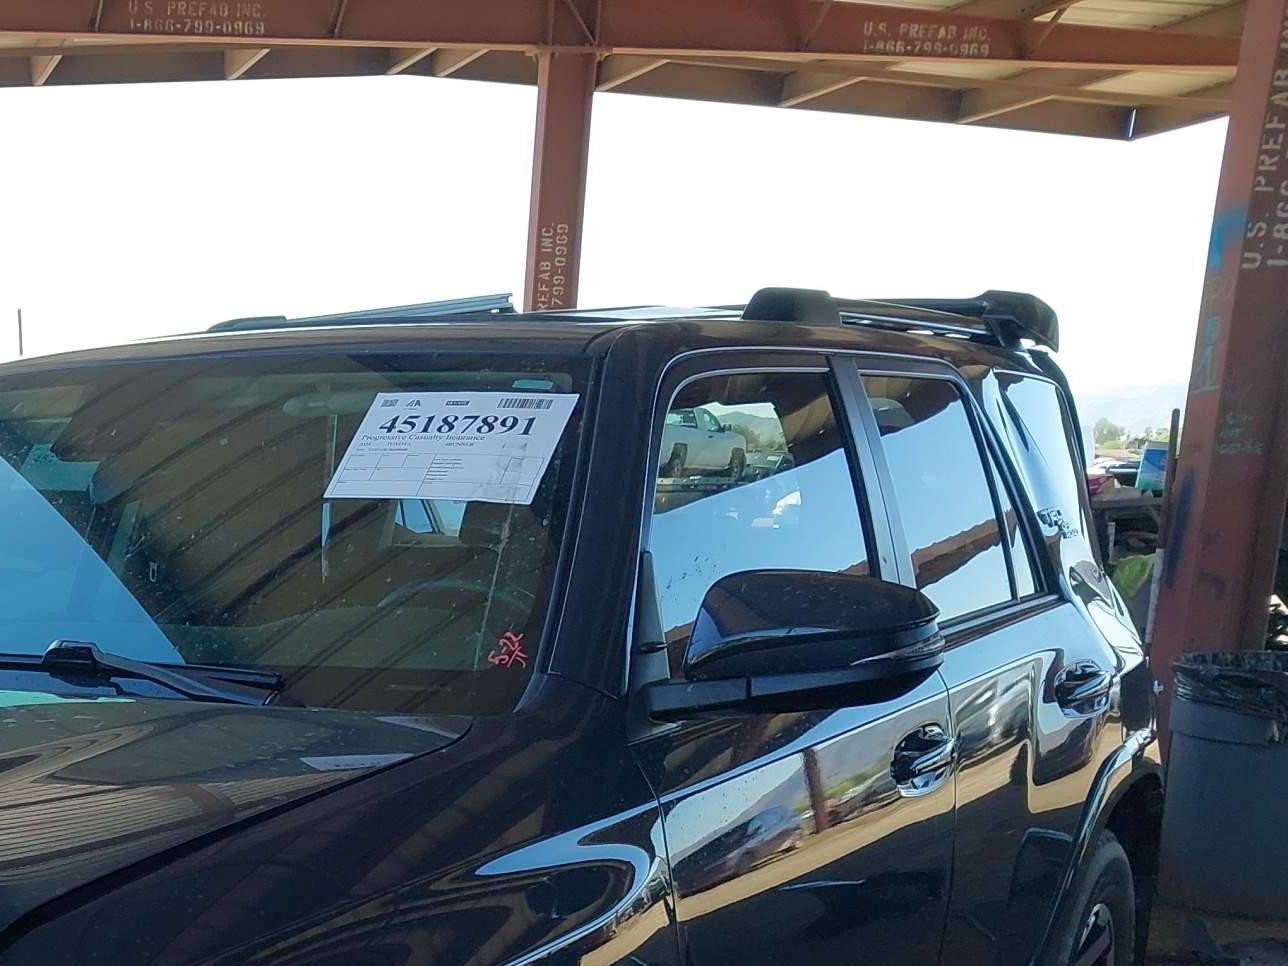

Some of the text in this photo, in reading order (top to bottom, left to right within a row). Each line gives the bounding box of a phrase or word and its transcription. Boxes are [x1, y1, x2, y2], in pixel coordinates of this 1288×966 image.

[168, 1, 229, 17] PREFAB
[130, 18, 265, 35] 1-866-799-0969
[899, 23, 958, 40] PREFAB
[962, 26, 991, 41] INC.
[1242, 69, 1288, 270] U.S. PREFAB
[540, 222, 554, 252] INC.
[551, 223, 569, 305] 799-0969
[379, 415, 537, 436] 45187891
[361, 434, 406, 442] Progressive
[408, 434, 443, 442] Casualty
